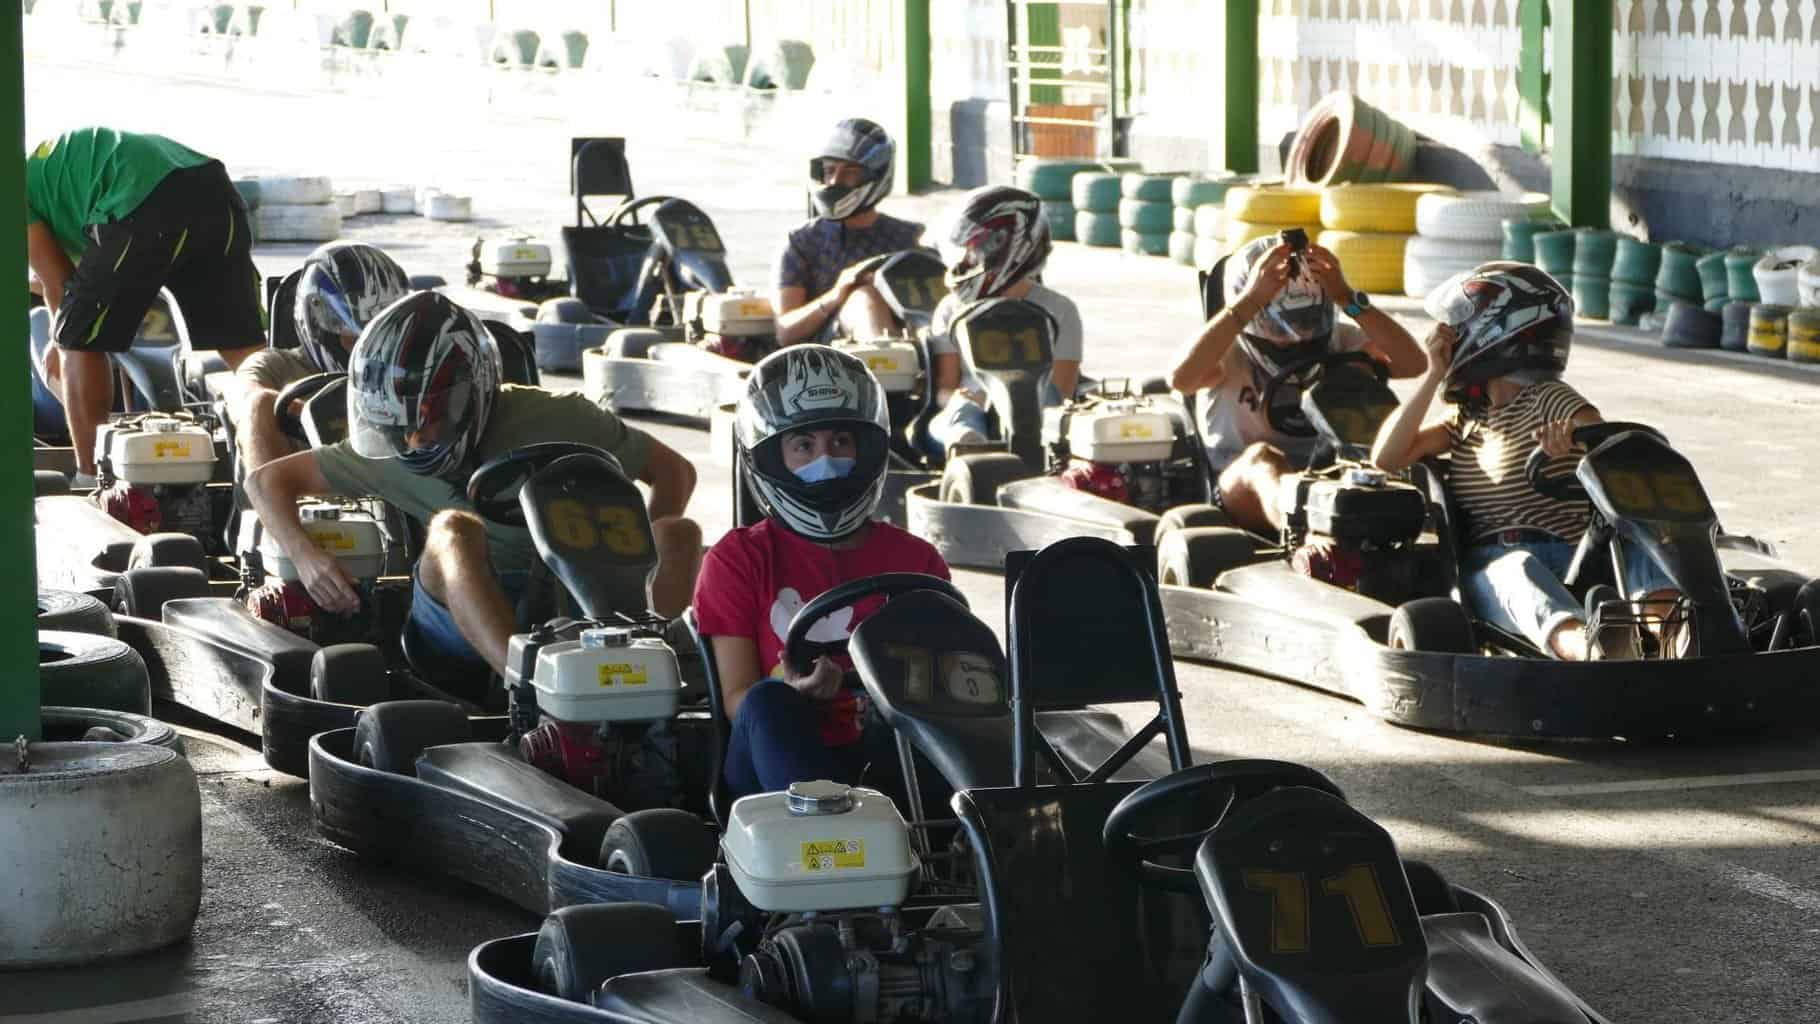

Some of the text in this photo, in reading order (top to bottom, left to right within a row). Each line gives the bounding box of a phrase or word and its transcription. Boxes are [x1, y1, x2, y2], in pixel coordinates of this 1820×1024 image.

[1606, 472, 1704, 512] 95
[546, 499, 648, 554] 63
[1242, 863, 1401, 952] 71
